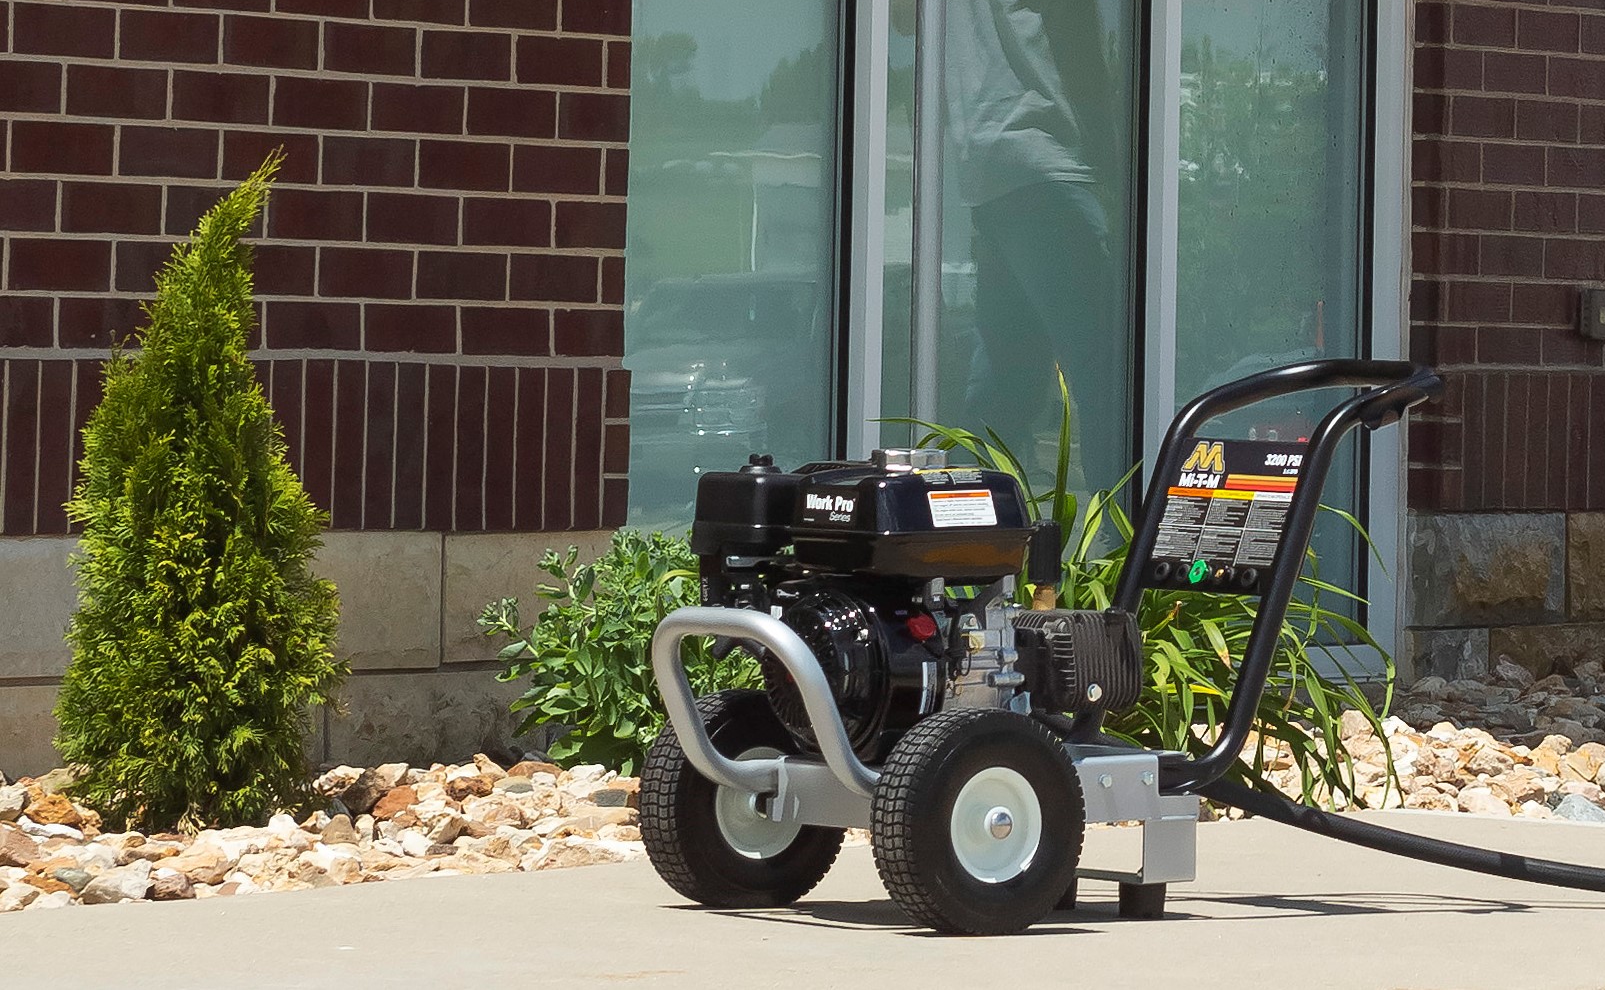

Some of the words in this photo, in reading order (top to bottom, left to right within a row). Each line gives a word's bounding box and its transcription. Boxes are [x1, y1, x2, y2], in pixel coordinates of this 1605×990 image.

[1264, 453, 1288, 467] 3200
[1287, 454, 1304, 467] PSI
[806, 493, 834, 511] Work
[834, 495, 854, 513] Pro
[829, 511, 851, 523] Series
